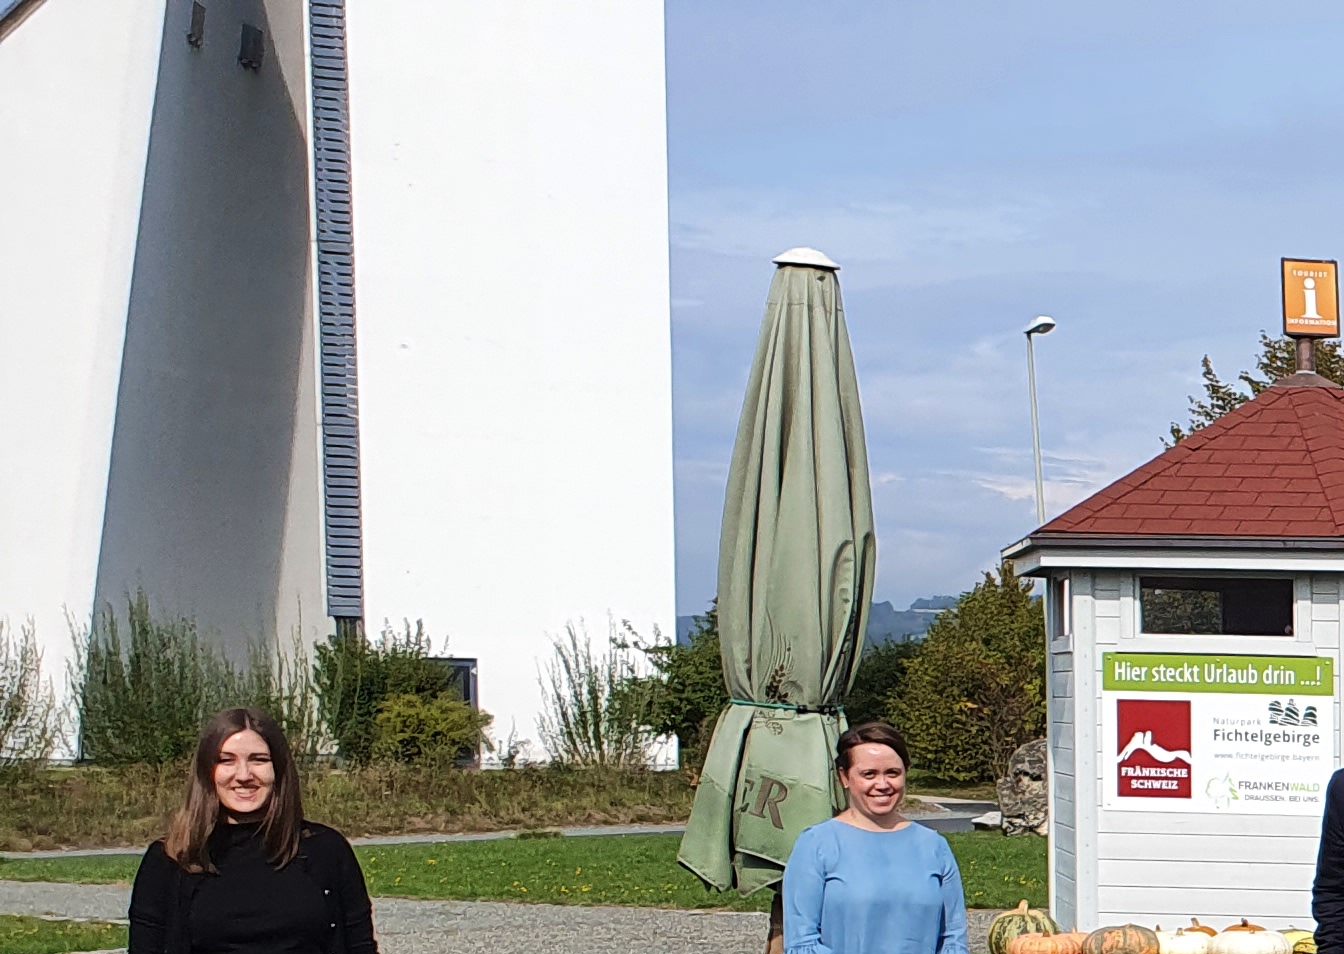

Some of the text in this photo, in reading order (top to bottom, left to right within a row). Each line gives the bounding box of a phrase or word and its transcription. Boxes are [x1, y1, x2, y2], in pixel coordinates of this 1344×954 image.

[1292, 269, 1328, 278] TOURIST
[1287, 318, 1337, 326] INFORMATION
[1114, 661, 1148, 681] Hier
[1151, 662, 1200, 683] steckt
[1204, 663, 1258, 684] Urlaub
[1262, 664, 1295, 685] drin
[1213, 717, 1261, 726] Naturpark
[1213, 729, 1320, 747] Fichtelgebirge
[1213, 752, 1320, 762] www.fichtelgebirge.bayern
[1121, 766, 1188, 777] FRÄNKISCHE
[1131, 779, 1179, 789] SCHWEIZ
[1238, 781, 1320, 792] FRANKENWALD
